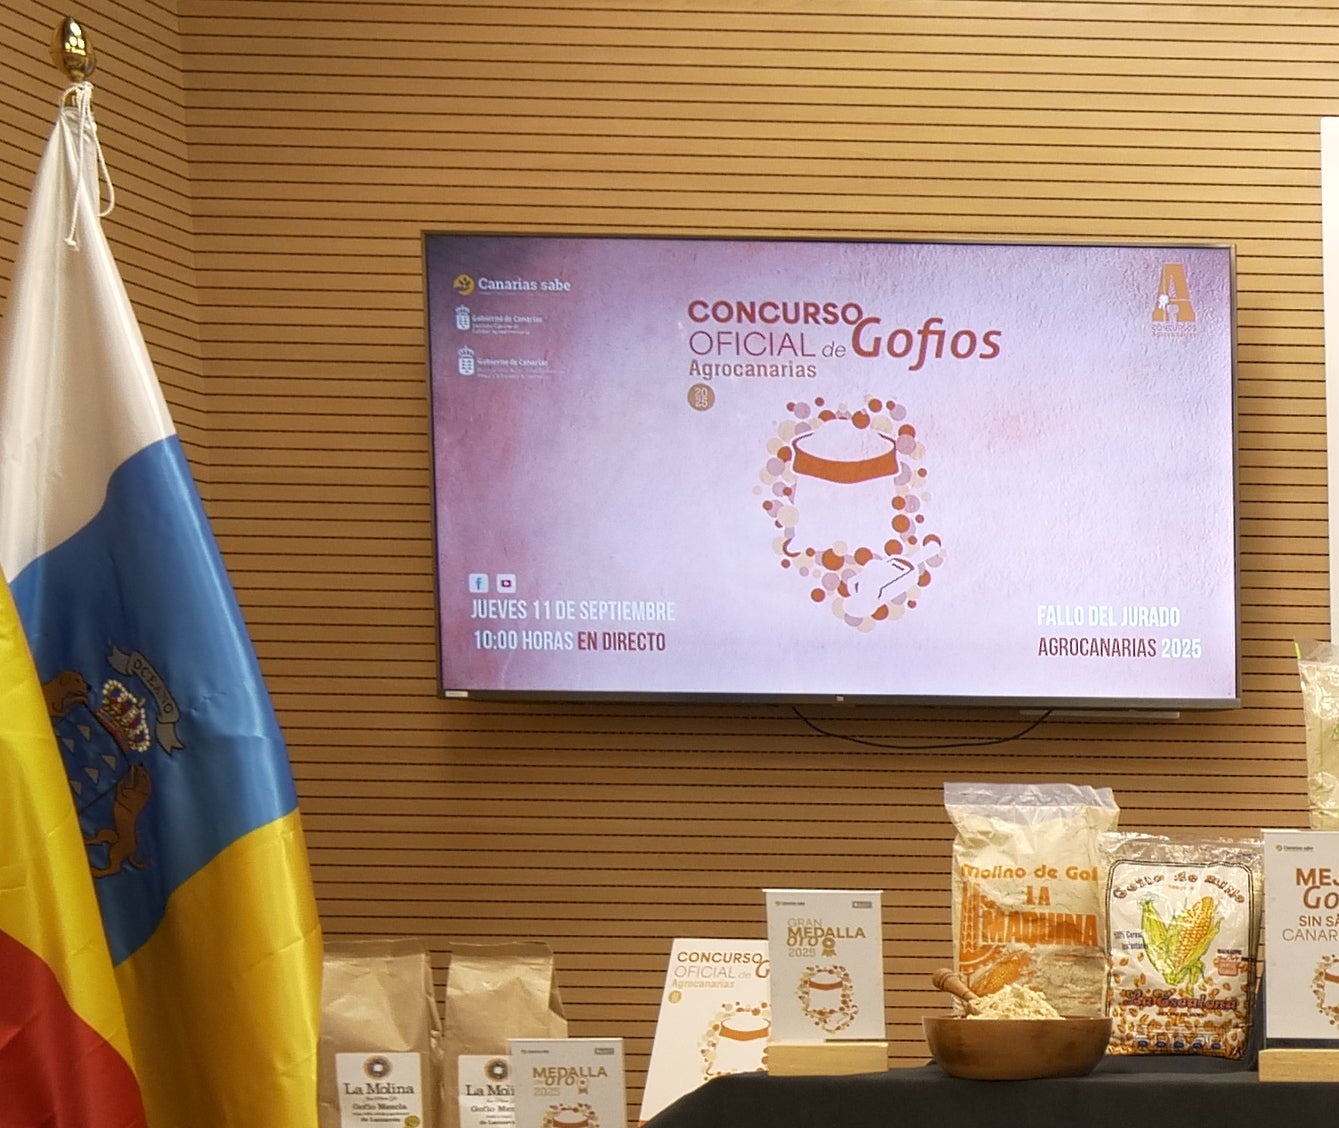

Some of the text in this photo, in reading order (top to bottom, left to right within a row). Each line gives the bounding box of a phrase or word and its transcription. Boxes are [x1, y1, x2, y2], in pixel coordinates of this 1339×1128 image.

[477, 276, 572, 292] Canarias sabe
[687, 299, 864, 325] CONCURSO
[689, 316, 1002, 371] OFICIAL de Gofios
[689, 358, 818, 381] Agrocanarias
[470, 599, 676, 621] JUEVES 11 DE SEPTIEMBRE
[1036, 604, 1181, 627] FALLO DEL JURADO
[473, 630, 666, 652] 10:00 HORAS EN DIRECTO
[1037, 636, 1202, 659] AGROCANARIAS 2025
[960, 863, 1058, 880] Molino de
[1026, 885, 1051, 906] LA
[787, 918, 822, 927] GRAN
[1298, 915, 1322, 928] SIN
[787, 926, 866, 939] MEDALLA
[786, 936, 818, 947] oro
[676, 951, 763, 964] CONCURSO
[788, 947, 816, 958] 2025
[674, 965, 735, 979] OFICIAL
[671, 978, 735, 989] Agrocanarias
[533, 1065, 608, 1079] MEDALLA
[544, 1075, 576, 1087] oro
[344, 1082, 415, 1096] La Molina
[465, 1084, 484, 1097] La
[534, 1086, 561, 1097] 2025
